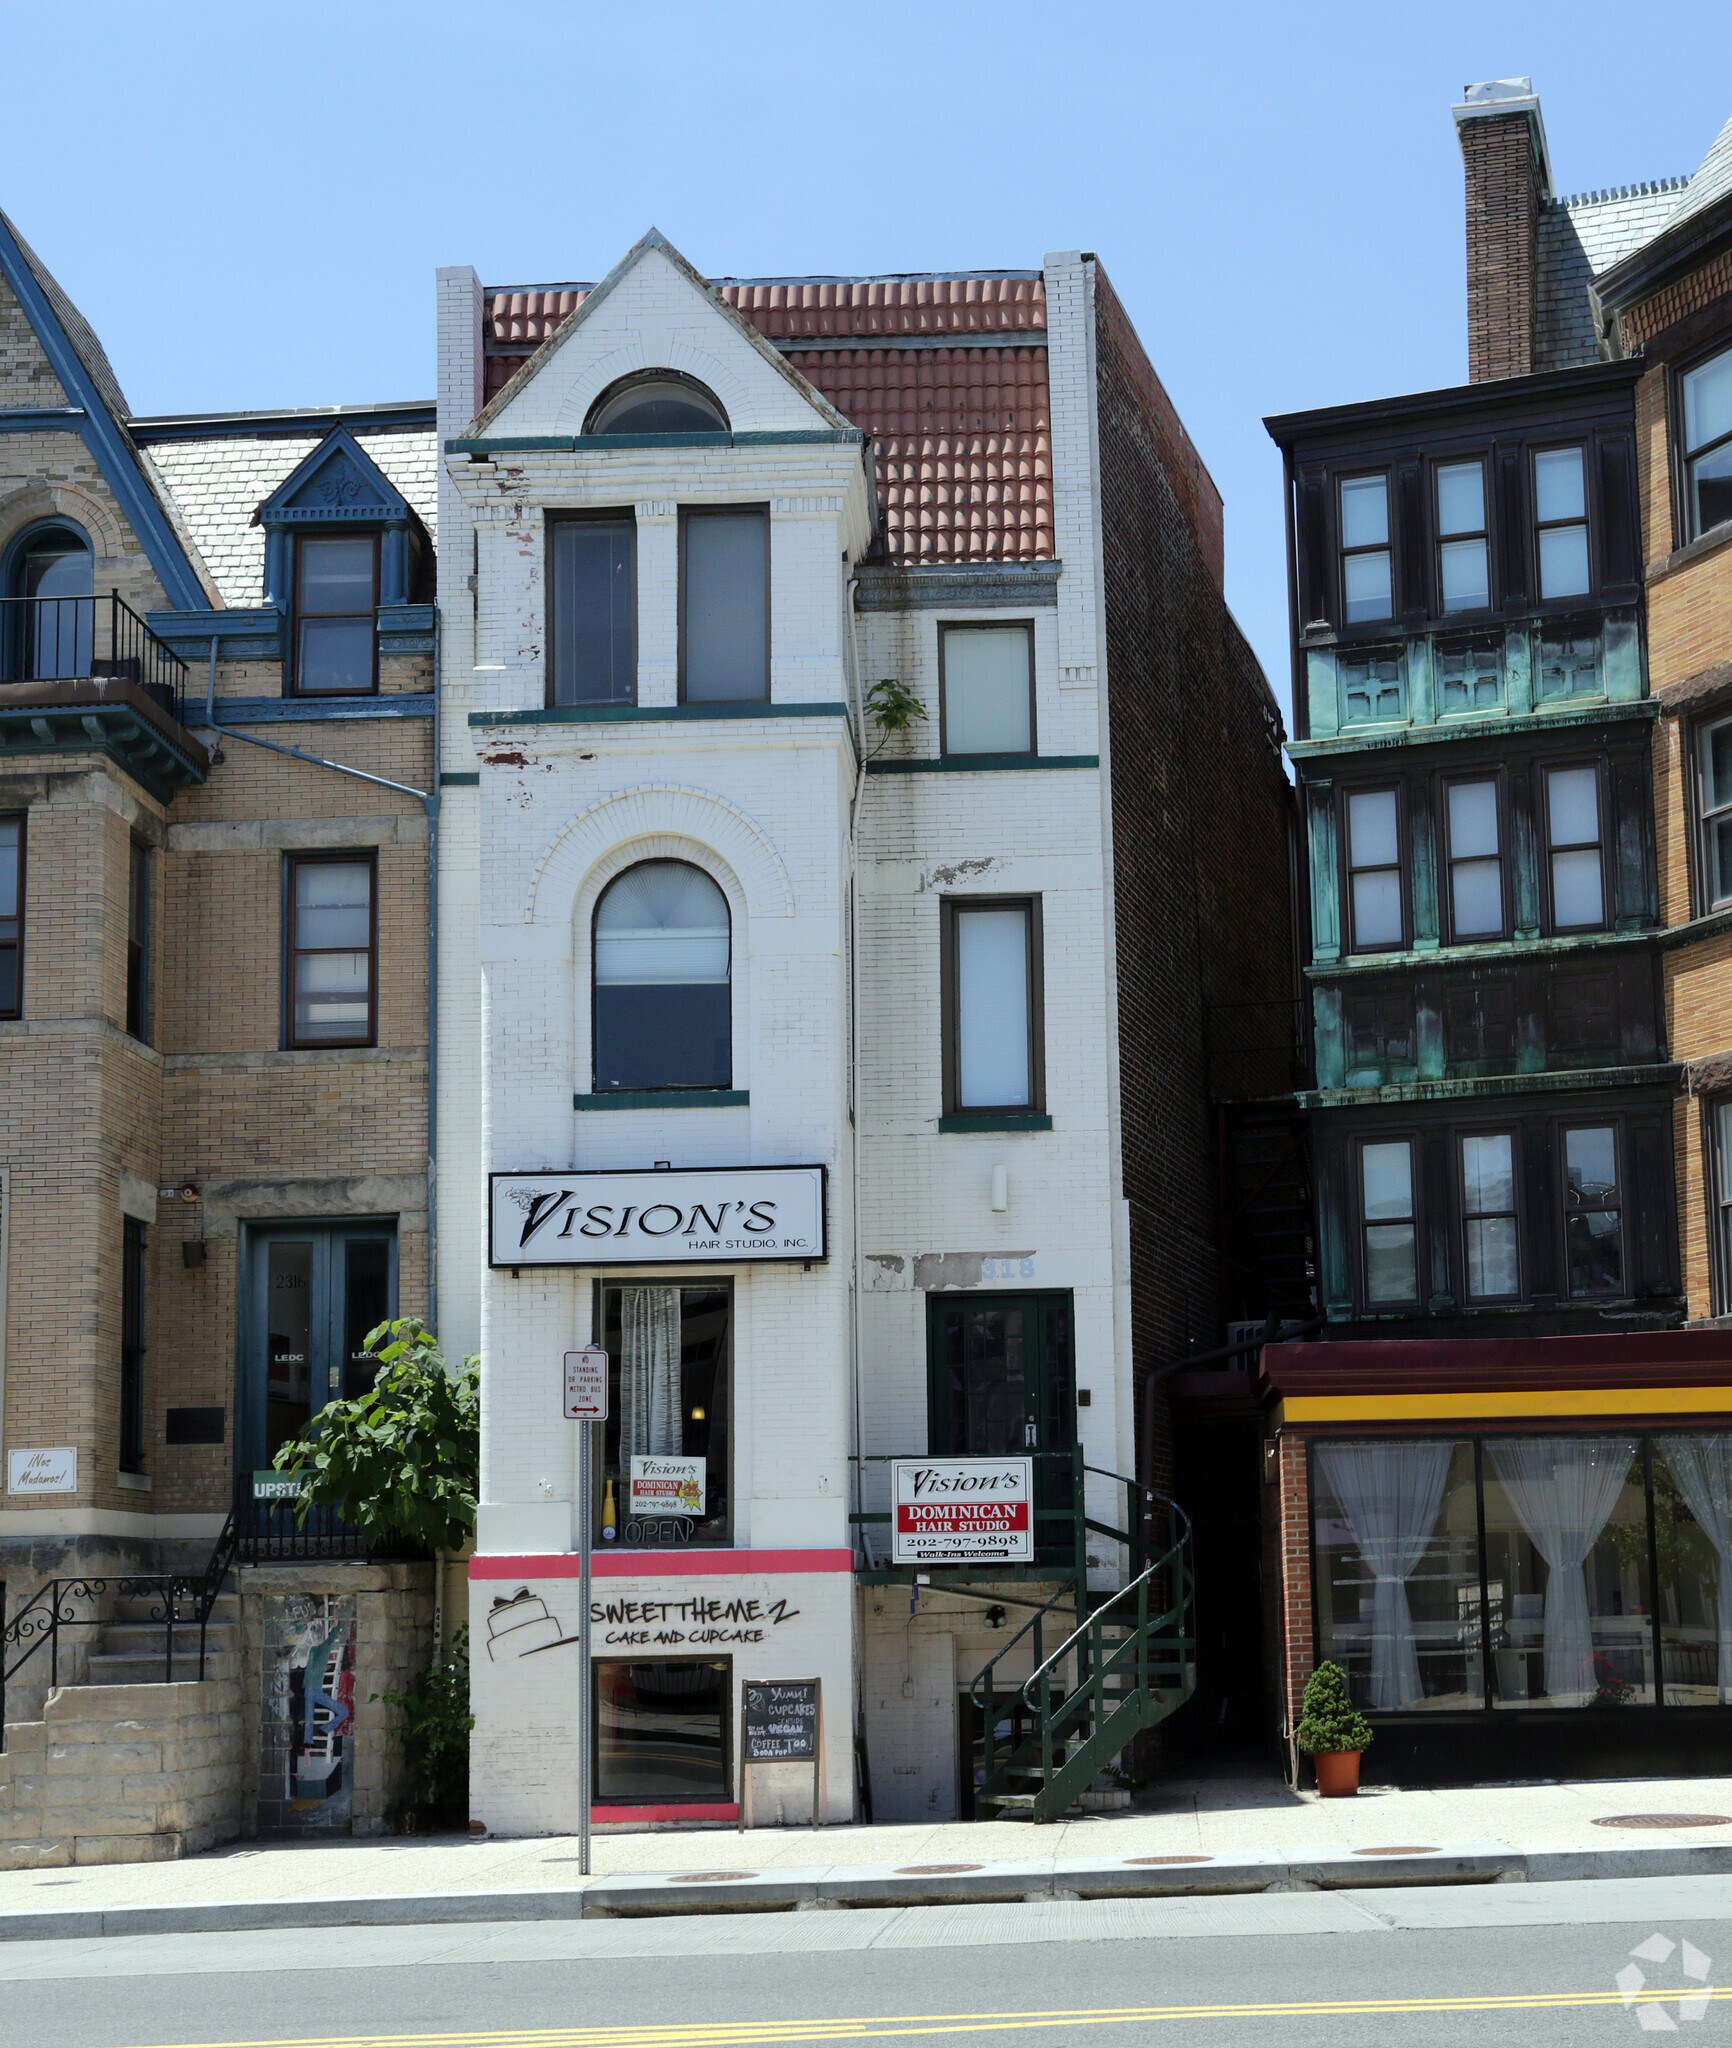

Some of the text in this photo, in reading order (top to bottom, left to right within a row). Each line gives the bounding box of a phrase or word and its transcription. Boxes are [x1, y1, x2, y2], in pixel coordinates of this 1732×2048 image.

[519, 1190, 777, 1247] VISION'S
[689, 1238, 808, 1249] HAIR STUDIO, INC.
[982, 1258, 1035, 1279] 318
[275, 1274, 306, 1289] 2316
[643, 1460, 697, 1476] Vision's
[637, 1480, 679, 1489] DOMINICAN
[914, 1469, 1020, 1498] Vision's
[635, 1501, 677, 1509] 202-797-9898
[908, 1504, 1017, 1520] DOMINICAN
[625, 1520, 691, 1543] OPEN
[916, 1520, 1010, 1532] HAIR STUDIO
[907, 1535, 1019, 1548] 202-797-9898
[605, 1629, 764, 1644] CAKE AND CUPCAKE
[768, 1704, 815, 1716] CUPCAKES
[768, 1724, 803, 1734] VEGAN
[751, 1738, 780, 1749] COFFEE
